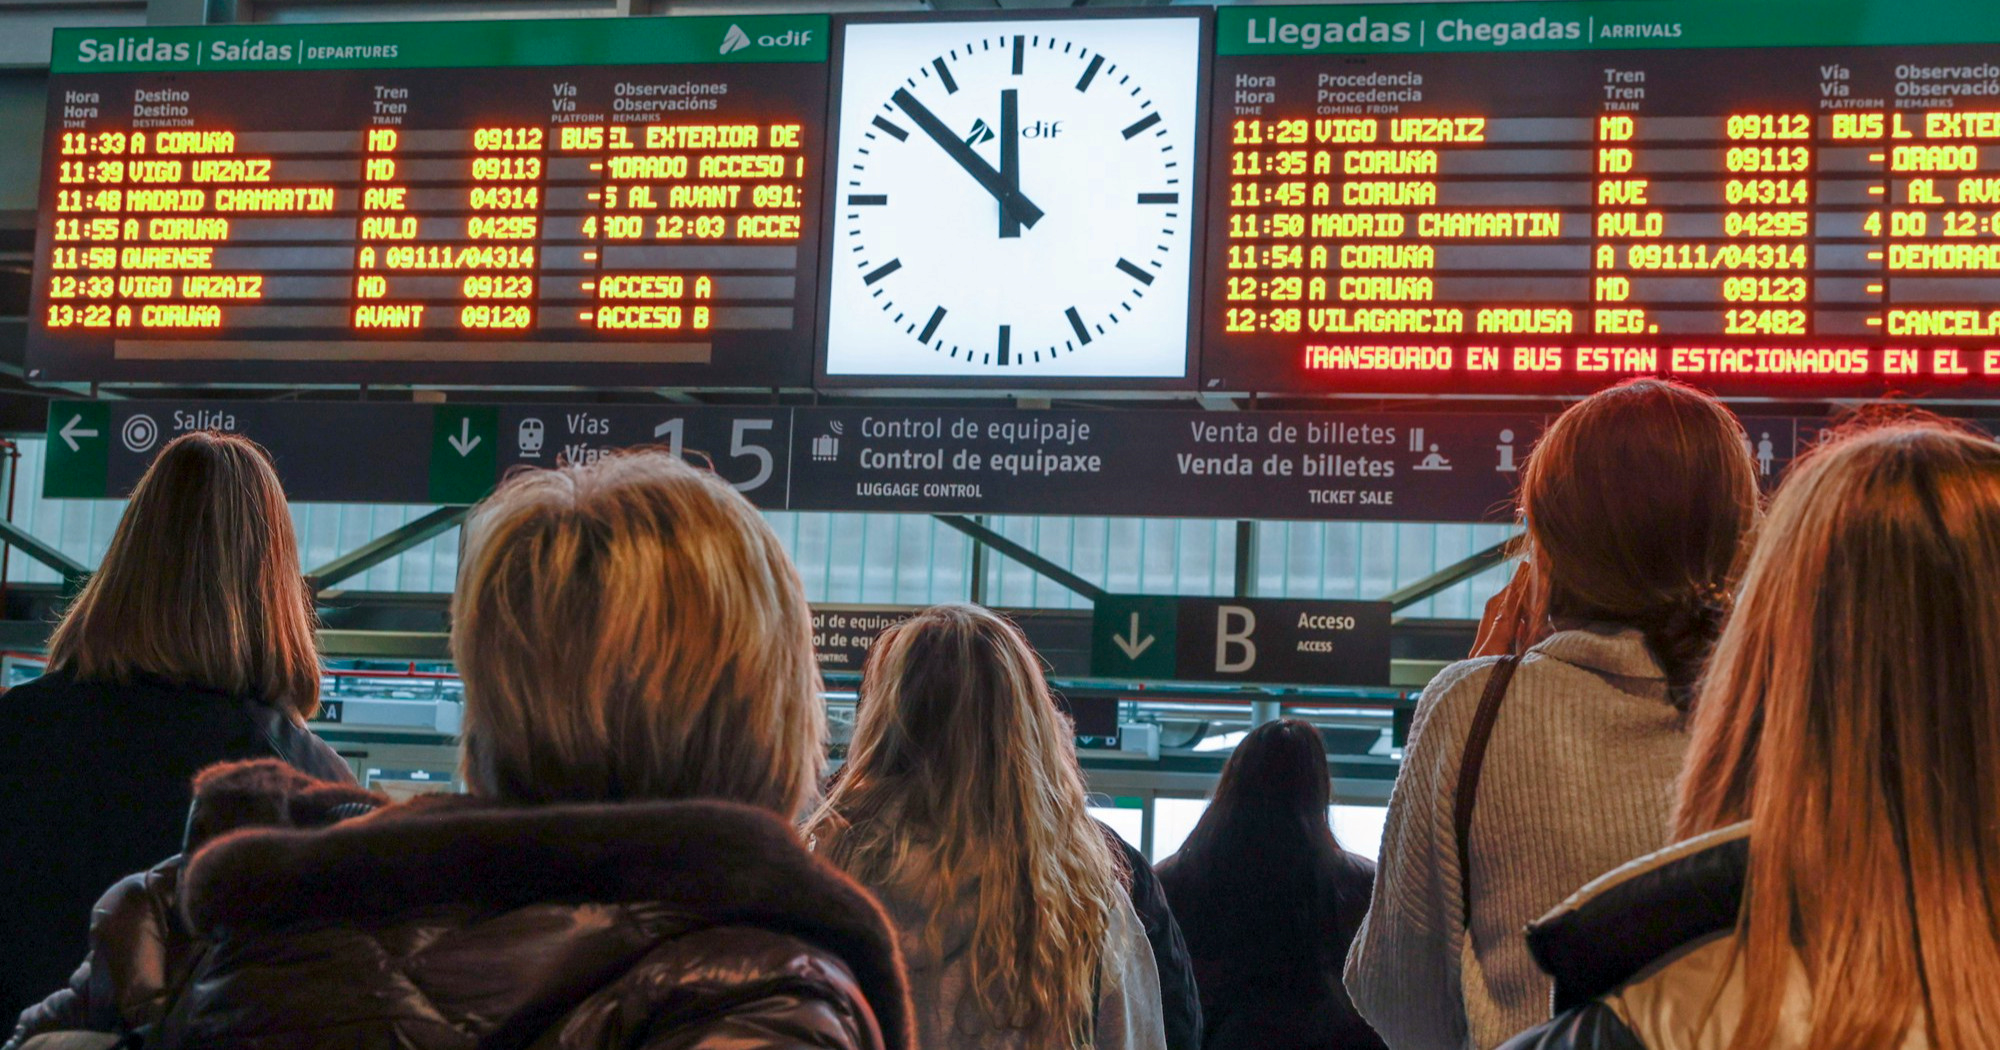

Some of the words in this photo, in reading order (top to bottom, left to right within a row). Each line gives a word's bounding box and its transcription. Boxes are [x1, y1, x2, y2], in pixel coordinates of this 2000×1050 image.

[757, 30, 813, 47] adif
[1247, 16, 1411, 50] Llegadas
[1436, 16, 1581, 46] Chegadas
[1600, 23, 1683, 38] ARRIVALS
[78, 37, 190, 63] Salidas
[211, 40, 293, 62] Saídas
[307, 44, 399, 61] DEPARTURES
[1235, 74, 1276, 88] Hora
[1317, 72, 1423, 88] Procedencia
[1604, 69, 1645, 83] Tren
[1820, 65, 1850, 81] Vía
[65, 90, 100, 104] Hora
[134, 89, 190, 103] Destino
[374, 86, 408, 99] Tren
[552, 83, 578, 98] Vía
[614, 81, 728, 97] Observaciones
[1235, 90, 1275, 104] Hora
[1317, 88, 1422, 103] Procedencia
[1604, 86, 1645, 100] Tren
[1820, 81, 1850, 97] Vía
[133, 104, 189, 118] Destino
[373, 101, 407, 115] Tren
[551, 98, 576, 112] Vía
[612, 97, 718, 112] Observacións
[1234, 106, 1262, 115] TIME
[1316, 105, 1363, 115] COMING
[1366, 104, 1400, 114] FROM
[1604, 102, 1640, 111] TRAIN
[1820, 99, 1885, 109] PLATFORM
[1895, 98, 1954, 108] REMARKS
[63, 105, 98, 119] Hora
[551, 113, 605, 124] PLATFORM
[612, 113, 661, 123] REMARKS
[63, 120, 86, 129] TIME
[132, 118, 194, 128] DESTINATION
[372, 116, 402, 125] TRAIN
[1233, 119, 1308, 143] 11:29
[1314, 118, 1378, 143] VIGO
[1390, 117, 1485, 143] URZAIZ
[1600, 116, 1634, 143] MD
[1727, 114, 1810, 143] 09112
[1832, 113, 1884, 143] BUS
[61, 131, 126, 154] 11:33
[130, 131, 146, 154] A
[155, 131, 235, 154] CORUÑA
[368, 129, 397, 154] MD
[474, 127, 543, 154] 09112
[560, 126, 604, 154] BUS
[646, 125, 759, 154] EXTERIOR
[770, 124, 801, 154] DE
[59, 160, 124, 181] 11:39
[128, 159, 182, 181] VIGO
[191, 159, 272, 181] URZAIZ
[366, 158, 395, 181] MD
[472, 157, 541, 181] 09113
[699, 155, 785, 181] ACCESO
[1232, 150, 1307, 174] 11:35
[1313, 149, 1331, 174] A
[1344, 149, 1438, 174] CORUÑA
[1599, 148, 1633, 174] MD
[1726, 146, 1809, 174] 09113
[57, 189, 121, 210] 11:48
[126, 188, 205, 210] MADRID
[215, 188, 334, 210] CHAMARTIN
[364, 187, 407, 210] AVE
[470, 187, 538, 210] 04314
[628, 185, 657, 210] AL
[669, 185, 741, 210] AVANT
[1230, 182, 1306, 206] 11:45
[1312, 181, 1330, 206] A
[1343, 181, 1436, 206] CORUÑA
[1598, 180, 1648, 206] AVE
[1725, 179, 1808, 206] 04314
[1908, 178, 1945, 206] AL
[54, 218, 120, 240] 11:55
[123, 218, 139, 240] A
[149, 218, 229, 240] CORUÑA
[362, 217, 418, 240] AVLO
[467, 216, 537, 240] 04295
[582, 215, 598, 240] 4
[655, 215, 726, 240] 12:03
[1229, 213, 1305, 237] 11:50
[1311, 212, 1405, 237] MADRID
[1418, 212, 1560, 237] CHAMARTIN
[1597, 212, 1663, 237] AVLO
[1724, 211, 1808, 237] 04295
[1863, 211, 1882, 237] 4
[52, 247, 117, 269] 11:58
[120, 247, 213, 269] OURENSE
[359, 246, 376, 269] A
[385, 246, 535, 269] 09111/04314
[1228, 244, 1303, 269] 11:54
[1310, 244, 1328, 269] A
[1340, 244, 1435, 269] CORUÑA
[1596, 244, 1615, 269] A
[1628, 244, 1807, 269] 09111/04314
[50, 276, 115, 298] 12:33
[118, 276, 173, 298] VIGO
[182, 276, 262, 298] URZAIZ
[357, 276, 386, 298] MD
[463, 276, 533, 298] 09123
[599, 276, 684, 298] ACCESO
[695, 276, 711, 298] A
[1227, 276, 1303, 302] 12:29
[1308, 276, 1326, 302] A
[1339, 276, 1433, 302] CORUÑA
[1596, 276, 1630, 302] MD
[1723, 277, 1807, 302] 09123
[47, 305, 112, 328] 13:22
[116, 305, 132, 328] A
[141, 305, 221, 328] CORUÑA
[355, 305, 424, 328] AVANT
[461, 305, 531, 328] 09120
[597, 305, 682, 328] ACCESO
[693, 305, 709, 328] B
[1226, 308, 1301, 335] 12:38
[1308, 308, 1463, 335] VILAGARCIA
[1476, 308, 1573, 335] AROUSA
[1595, 309, 1658, 335] REG.
[1724, 309, 1806, 335] 12482
[1466, 347, 1499, 373] EN
[1513, 347, 1562, 373] BUS
[1576, 347, 1657, 373] ESTAN
[1671, 348, 1868, 373] ESTACIONADOS
[1883, 349, 1918, 373] EN
[1933, 350, 1968, 373] EL
[173, 410, 236, 431] Salida
[566, 412, 610, 435] Vías
[861, 415, 942, 441] Control
[950, 417, 979, 440] de
[987, 418, 1091, 445] equipaje
[1190, 420, 1258, 444] Venta
[1268, 421, 1298, 444] de
[1307, 421, 1396, 445] billetes
[729, 418, 774, 493] 5
[859, 447, 944, 470] Control
[952, 448, 982, 471] de
[990, 450, 1101, 476] equipaxe
[1177, 453, 1253, 476] Venda
[1262, 453, 1293, 477] de
[1302, 454, 1395, 478] billetes
[856, 482, 919, 498] LUGGAGE
[923, 483, 982, 498] CONTROL
[1308, 489, 1356, 505] TICKET
[1359, 490, 1393, 505] SALE
[828, 614, 846, 627] de
[1297, 611, 1356, 631] Acceso
[829, 633, 848, 647] de
[1215, 605, 1257, 674] B
[1296, 640, 1333, 653] ACCESS
[326, 704, 337, 719] A
